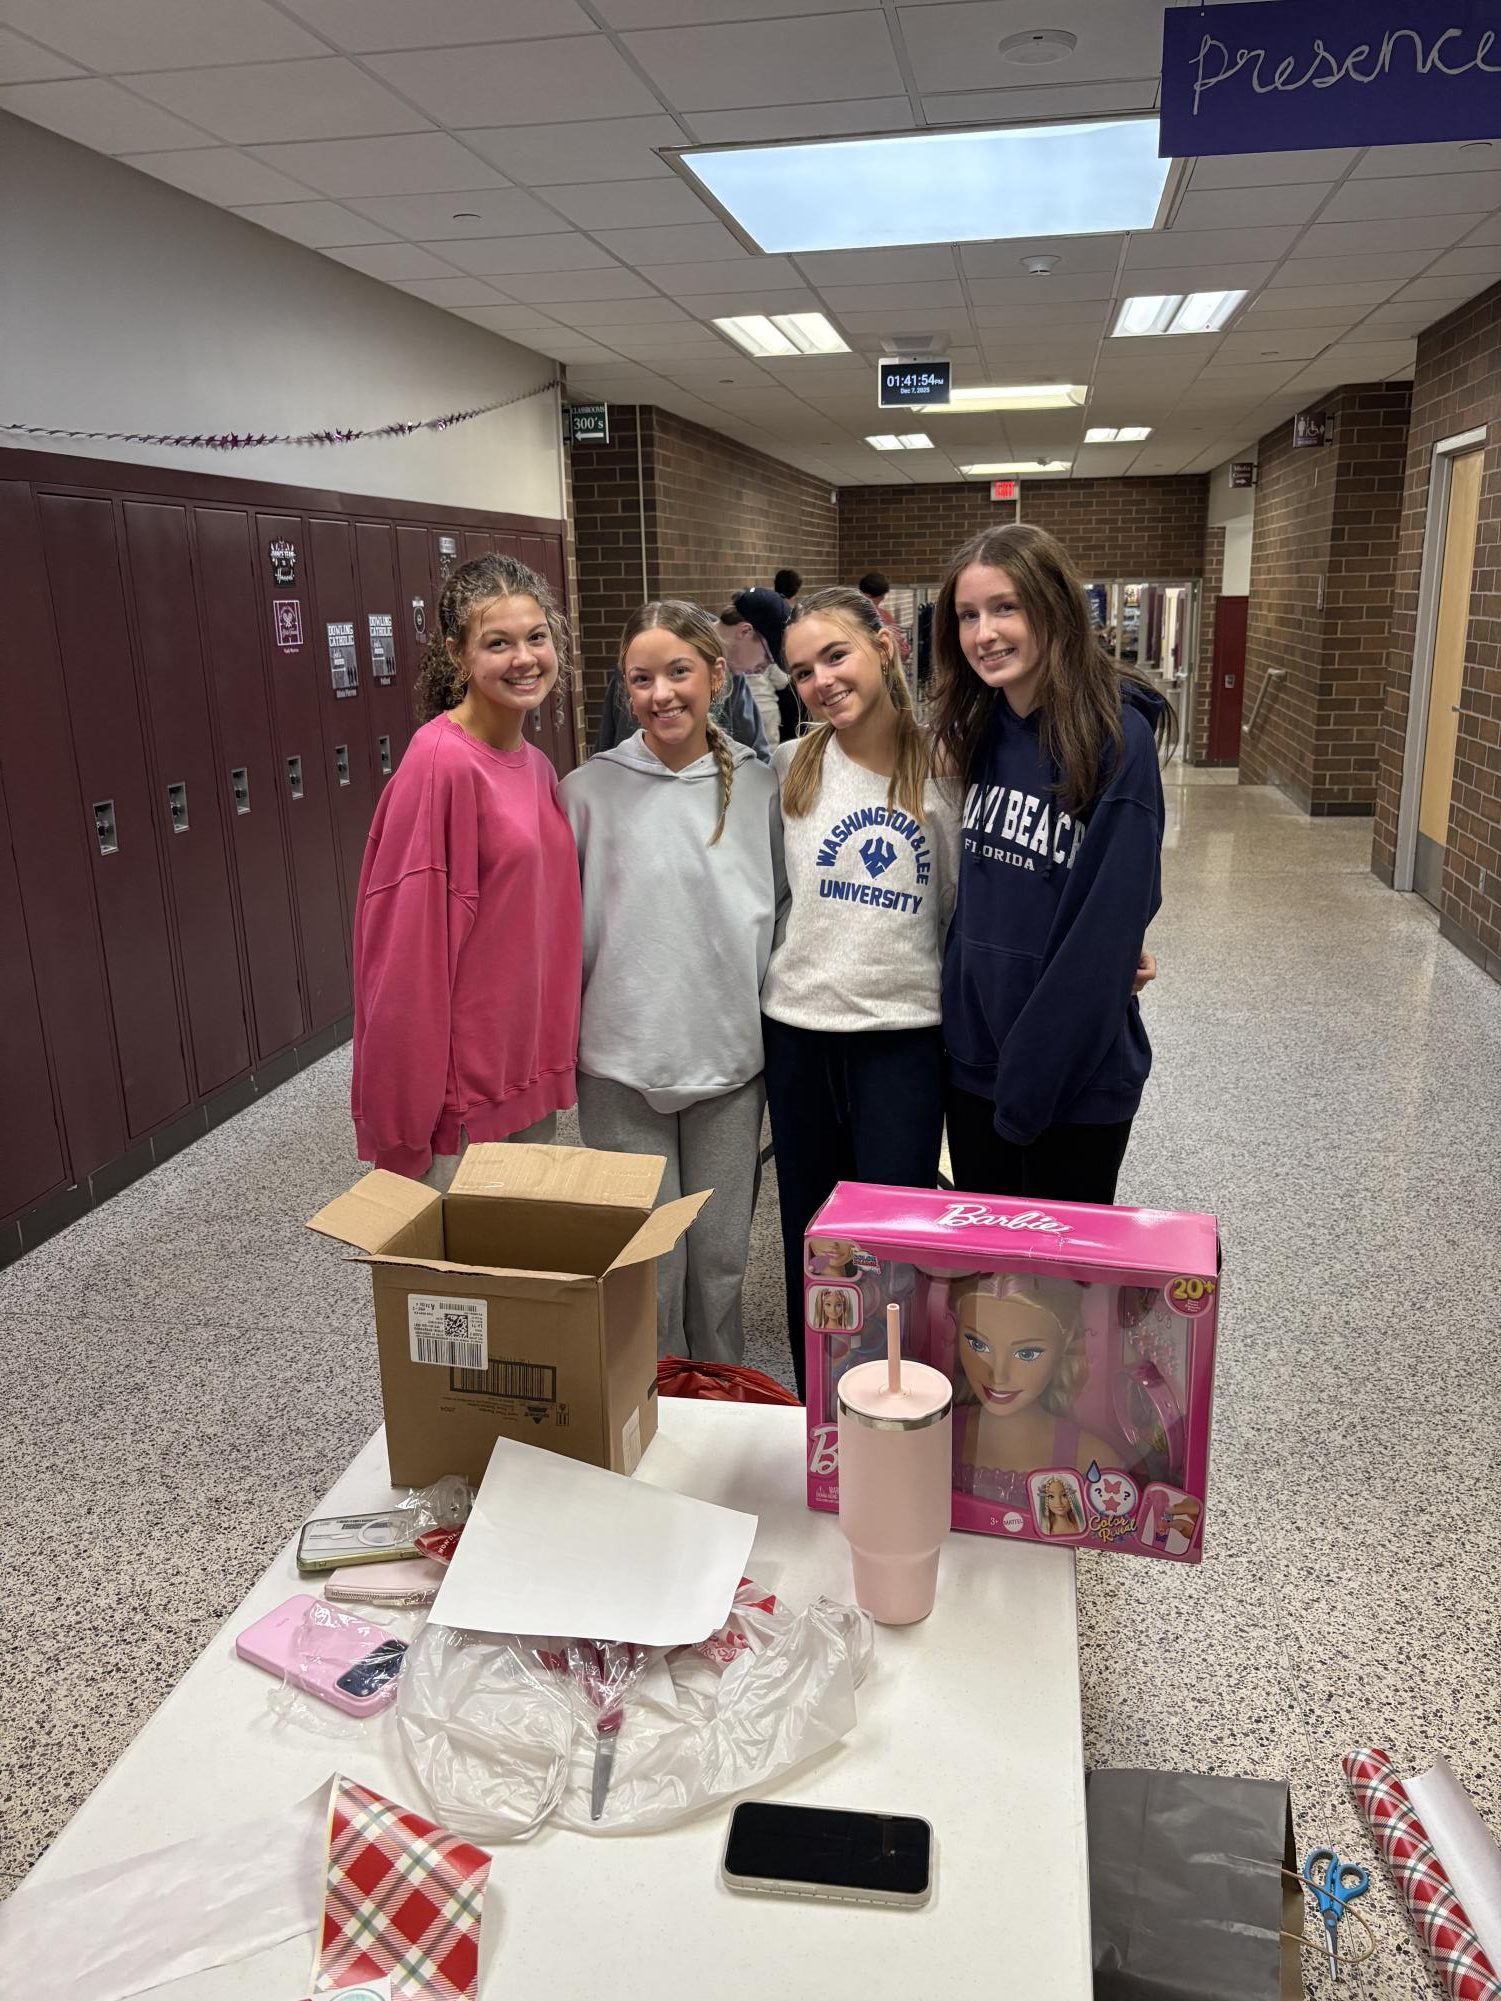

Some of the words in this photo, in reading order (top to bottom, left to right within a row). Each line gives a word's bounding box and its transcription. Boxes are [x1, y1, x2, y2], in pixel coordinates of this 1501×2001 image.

[1189, 29, 1501, 115] presence
[574, 417, 604, 430] 300's
[964, 838, 1035, 871] FLORIDA
[819, 879, 923, 914] UNIVERSITY
[936, 1203, 1072, 1232] Barbie
[1088, 1513, 1128, 1531] Color
[1100, 1517, 1138, 1543] Reveal
